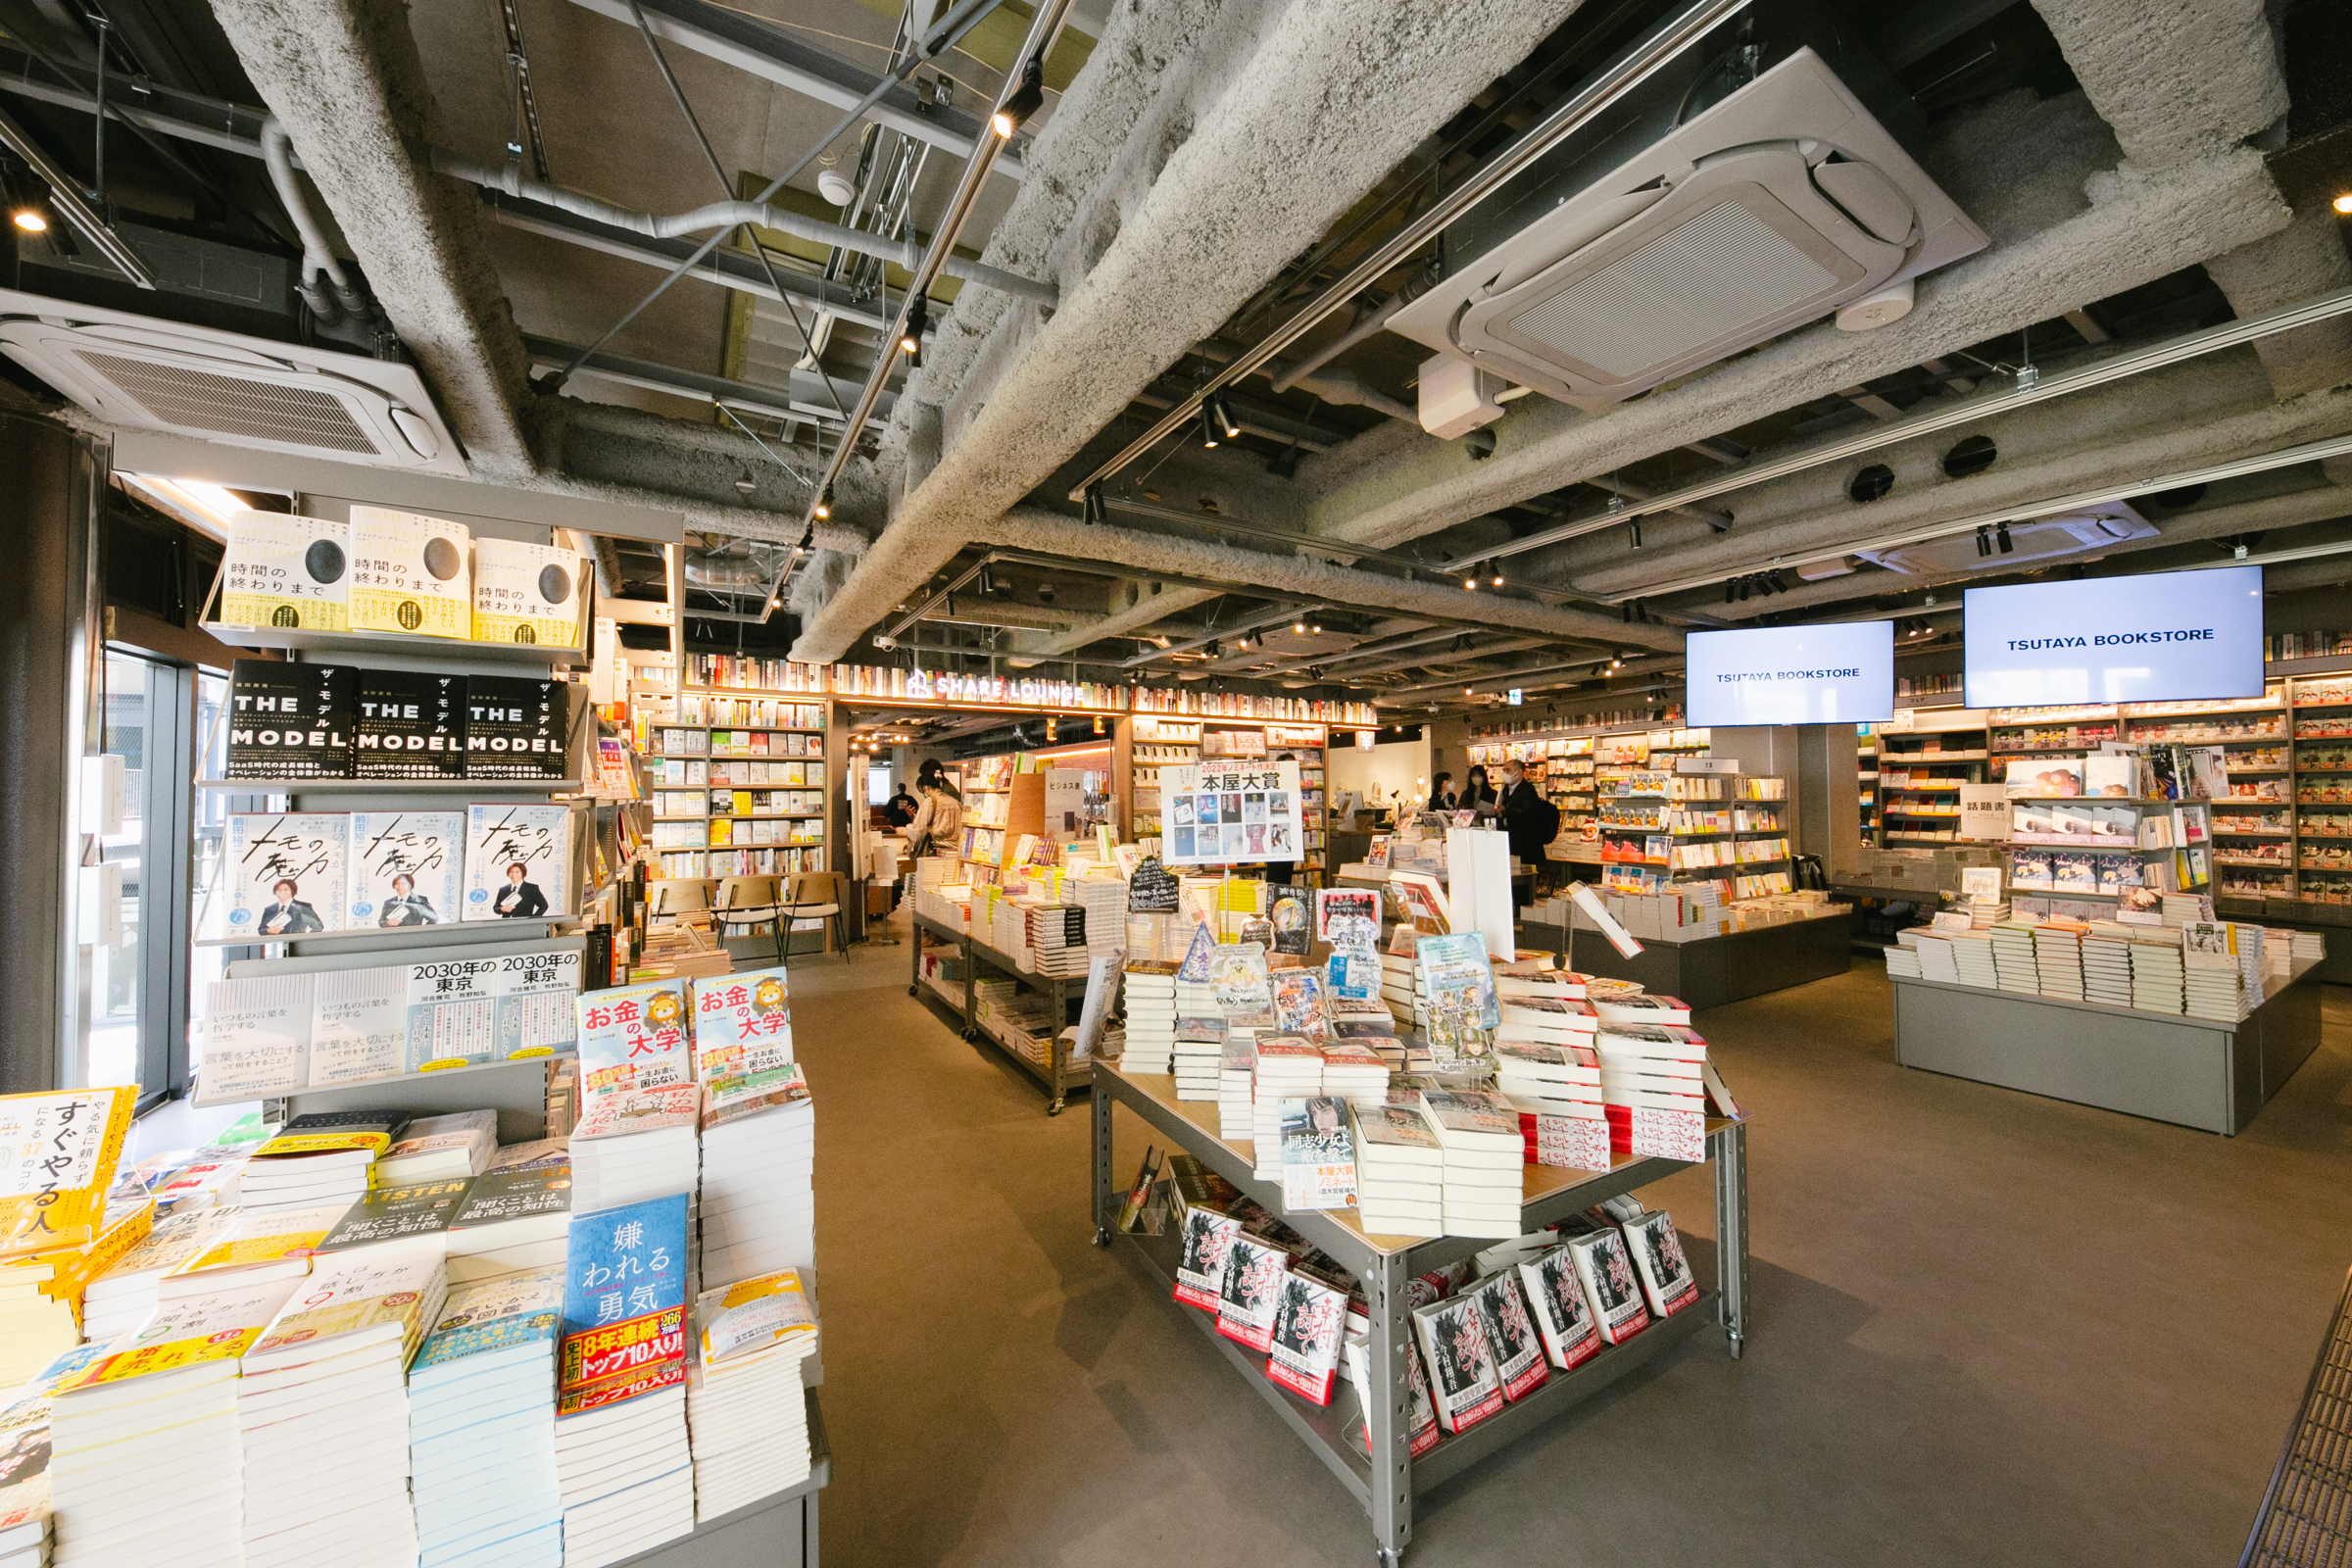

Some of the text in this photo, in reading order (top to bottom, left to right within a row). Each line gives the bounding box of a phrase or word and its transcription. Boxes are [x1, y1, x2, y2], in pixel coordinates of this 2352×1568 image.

[230, 563, 287, 579] 時間の
[355, 558, 408, 574] 時間の
[228, 576, 324, 597] 終わりまで
[354, 571, 443, 593] 終わりまで
[478, 587, 524, 601] 時間の
[478, 600, 556, 615] 終わりまで
[2007, 628, 2215, 651] TSUTAYA BOOKSTORE
[1717, 667, 1861, 683] TSUTAYA BOOKSTORE
[316, 668, 334, 727] ザ・モデル
[936, 676, 1085, 702] SHARE LOUNGE
[234, 695, 298, 712] THE
[362, 703, 419, 719] THE
[435, 678, 452, 733] ザ・モデル
[469, 707, 522, 722] THE
[537, 683, 551, 736] ザ・モデル
[230, 729, 347, 747] MODEL
[358, 734, 464, 752] MODEL
[467, 736, 564, 754] MODEL
[1201, 762, 1281, 773] 2022年ノミネート作決定!
[1050, 781, 1081, 791] ビジネス書
[1201, 772, 1282, 791] 本屋大賞
[1967, 802, 2007, 811] 話題書
[353, 814, 367, 850] 前田裕二
[471, 806, 484, 839] 前田裕二
[480, 806, 550, 850] メモの
[231, 816, 245, 853] 前田裕二
[241, 815, 324, 863] メモの
[363, 813, 439, 859] メモの
[414, 959, 497, 981] 2030年の
[502, 954, 579, 972] 2030年の
[435, 975, 473, 993] 東京
[522, 967, 558, 985] 東京
[322, 998, 390, 1011] いつもの言葉を
[700, 985, 750, 1013] お金
[214, 1008, 288, 1023] いつもの言葉を
[321, 1009, 362, 1022] 哲学する
[585, 1000, 641, 1031] お金
[736, 1006, 751, 1018] の
[213, 1021, 256, 1033] 哲学する
[626, 1022, 641, 1035] の
[737, 1012, 787, 1041] 大学
[314, 1033, 406, 1054] 言葉を大切にする
[627, 1027, 682, 1059] 大学
[745, 1047, 781, 1059] 一生お金に
[204, 1045, 306, 1065] 言葉を大切にする
[749, 1055, 784, 1069] 困らない
[637, 1065, 677, 1078] 一生お金に
[640, 1074, 679, 1089] 困らない
[74, 1100, 106, 1184] やる気に頼らず
[101, 1112, 122, 1166] すぐやる人
[1300, 1147, 1350, 1163] 敵を撃て
[1316, 1164, 1354, 1177] 本屋大賞
[363, 1181, 466, 1205] LISTEN
[1318, 1177, 1355, 1188] ノミネート
[460, 1199, 565, 1221] 最高の知性
[326, 1219, 444, 1246] 最高の知性
[613, 1220, 644, 1252] 嫌
[1182, 1231, 1195, 1268] 今村翔吾
[327, 1264, 370, 1280] 人は
[582, 1247, 670, 1288] われる
[318, 1265, 413, 1293] 話し方が
[1224, 1260, 1237, 1300] 今村翔吾
[1242, 1262, 1261, 1309] 討て
[170, 1298, 219, 1312] 人は
[304, 1284, 366, 1311] 9割
[465, 1291, 543, 1314] 言いかえ
[596, 1283, 659, 1325] 勇気
[156, 1297, 267, 1325] 聞き方が
[476, 1302, 522, 1321] 図鑑
[661, 1311, 682, 1328] 266
[1276, 1299, 1289, 1342] 今村翔吾
[136, 1318, 208, 1347] 9割
[582, 1318, 660, 1358] 8年連続
[1296, 1301, 1318, 1355] 討て
[1489, 1316, 1508, 1361] 今村翔吾
[565, 1341, 581, 1382] 史上初
[581, 1332, 683, 1380] トップ10入り!
[1452, 1331, 1479, 1383] 討て
[1440, 1343, 1458, 1392] 今村翔吾
[579, 1369, 683, 1409] トップ10入り!
